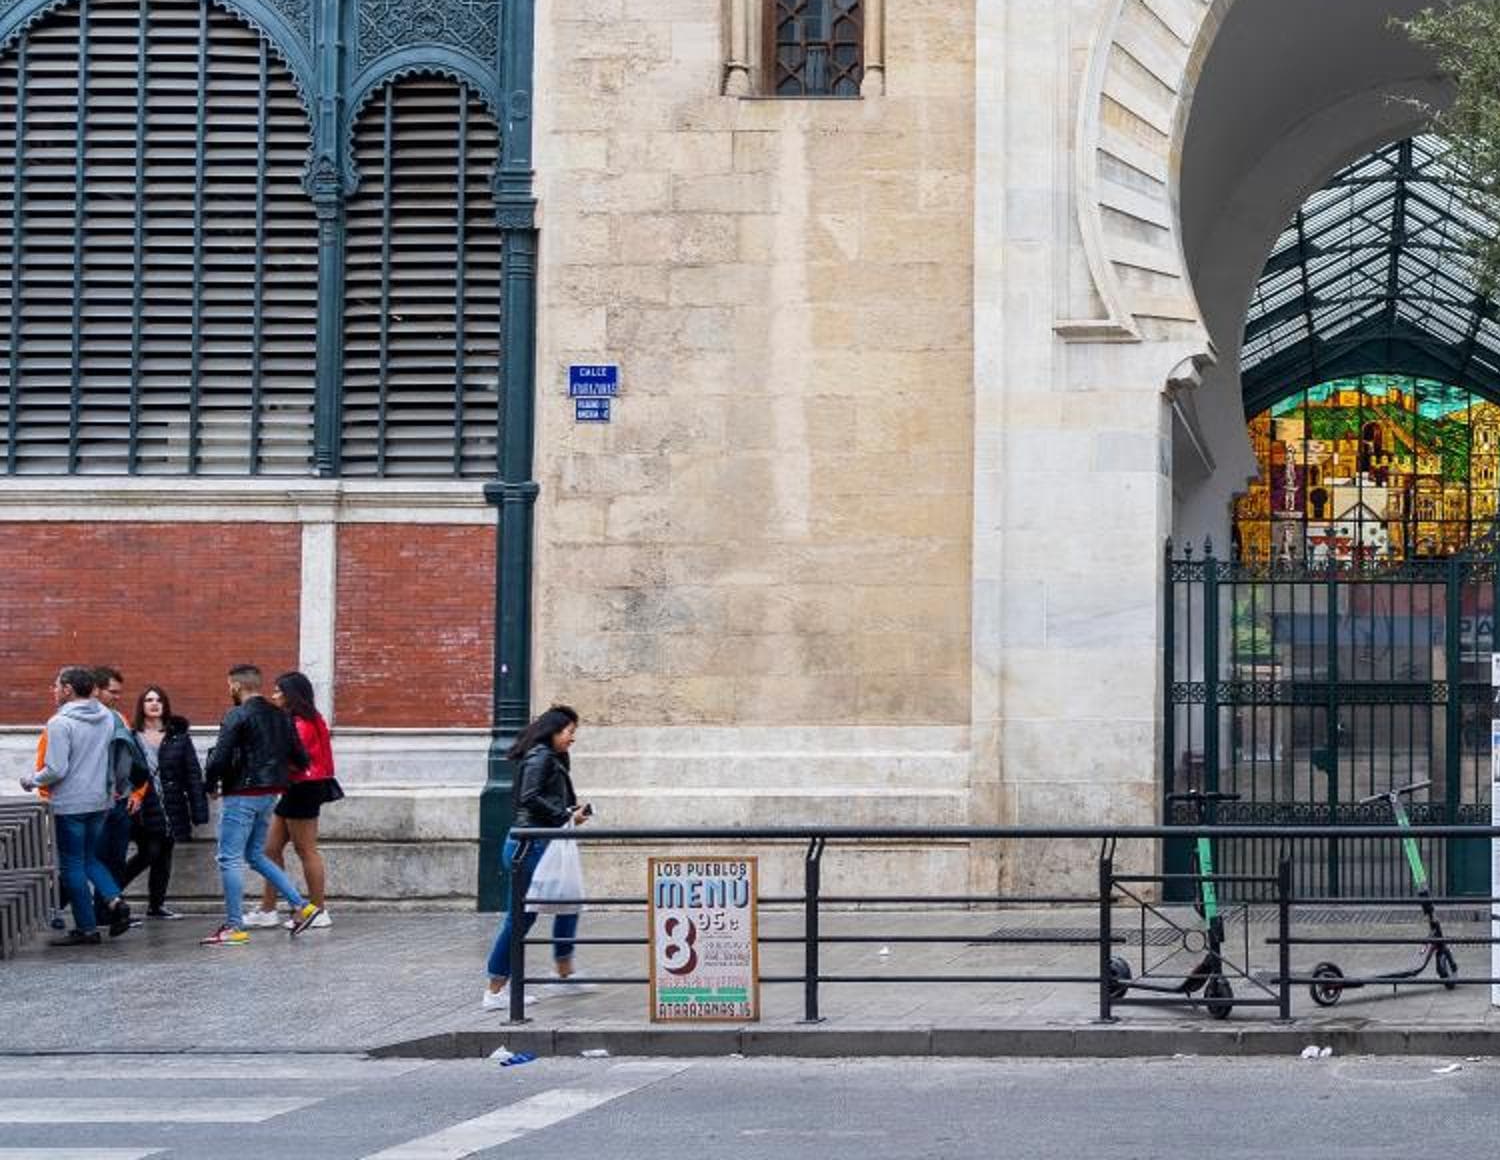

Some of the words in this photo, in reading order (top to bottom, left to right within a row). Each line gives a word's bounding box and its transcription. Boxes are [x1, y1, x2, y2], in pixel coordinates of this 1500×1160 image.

[580, 367, 607, 377] CALLE
[657, 863, 681, 877] LOS
[687, 863, 747, 877] PUEBLOS
[656, 875, 749, 909] MENÚ
[659, 914, 697, 976] 8
